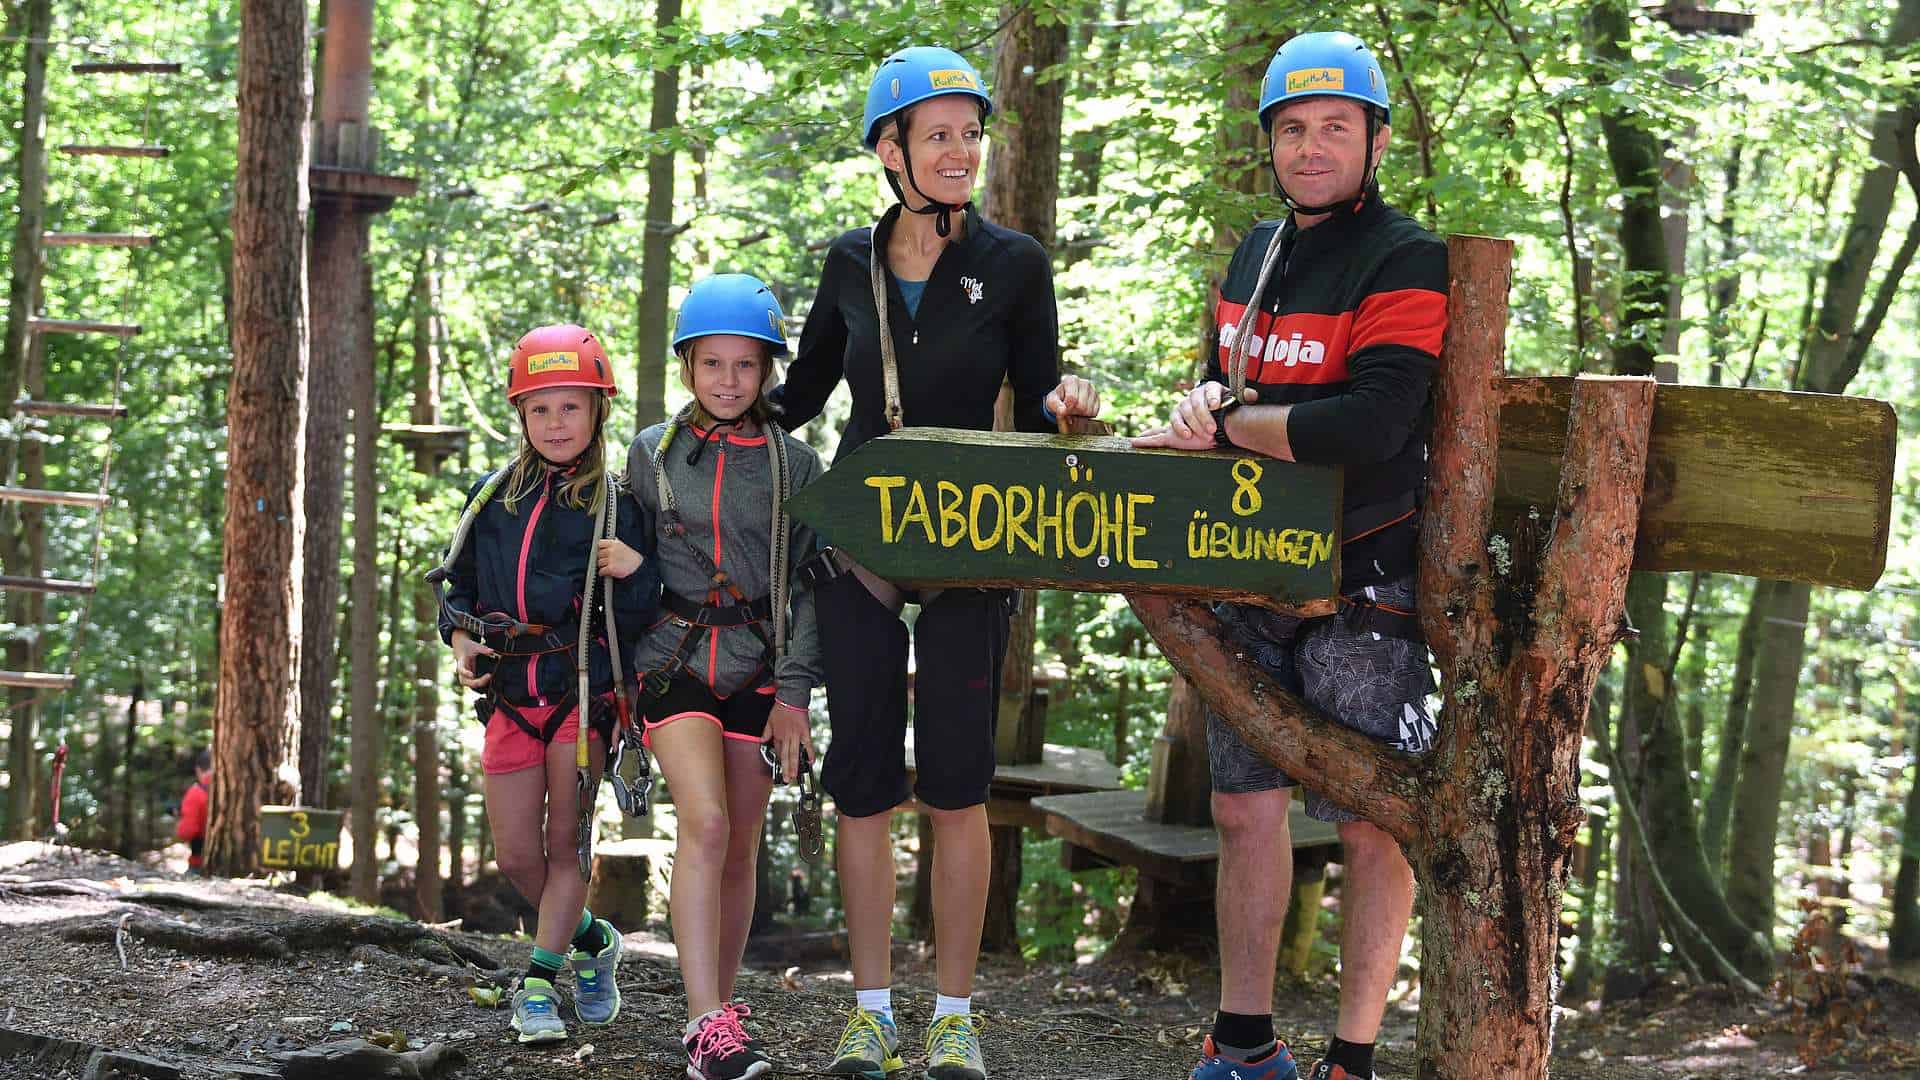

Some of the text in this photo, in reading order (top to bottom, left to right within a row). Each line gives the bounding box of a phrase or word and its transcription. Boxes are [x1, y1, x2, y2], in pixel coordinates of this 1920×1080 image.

[1231, 458, 1263, 516] 8
[864, 467, 1158, 569] TABORHÖHE
[1187, 509, 1335, 569] ÜBUNGEN
[263, 837, 338, 868] LEICHT
[289, 812, 311, 838] 3
